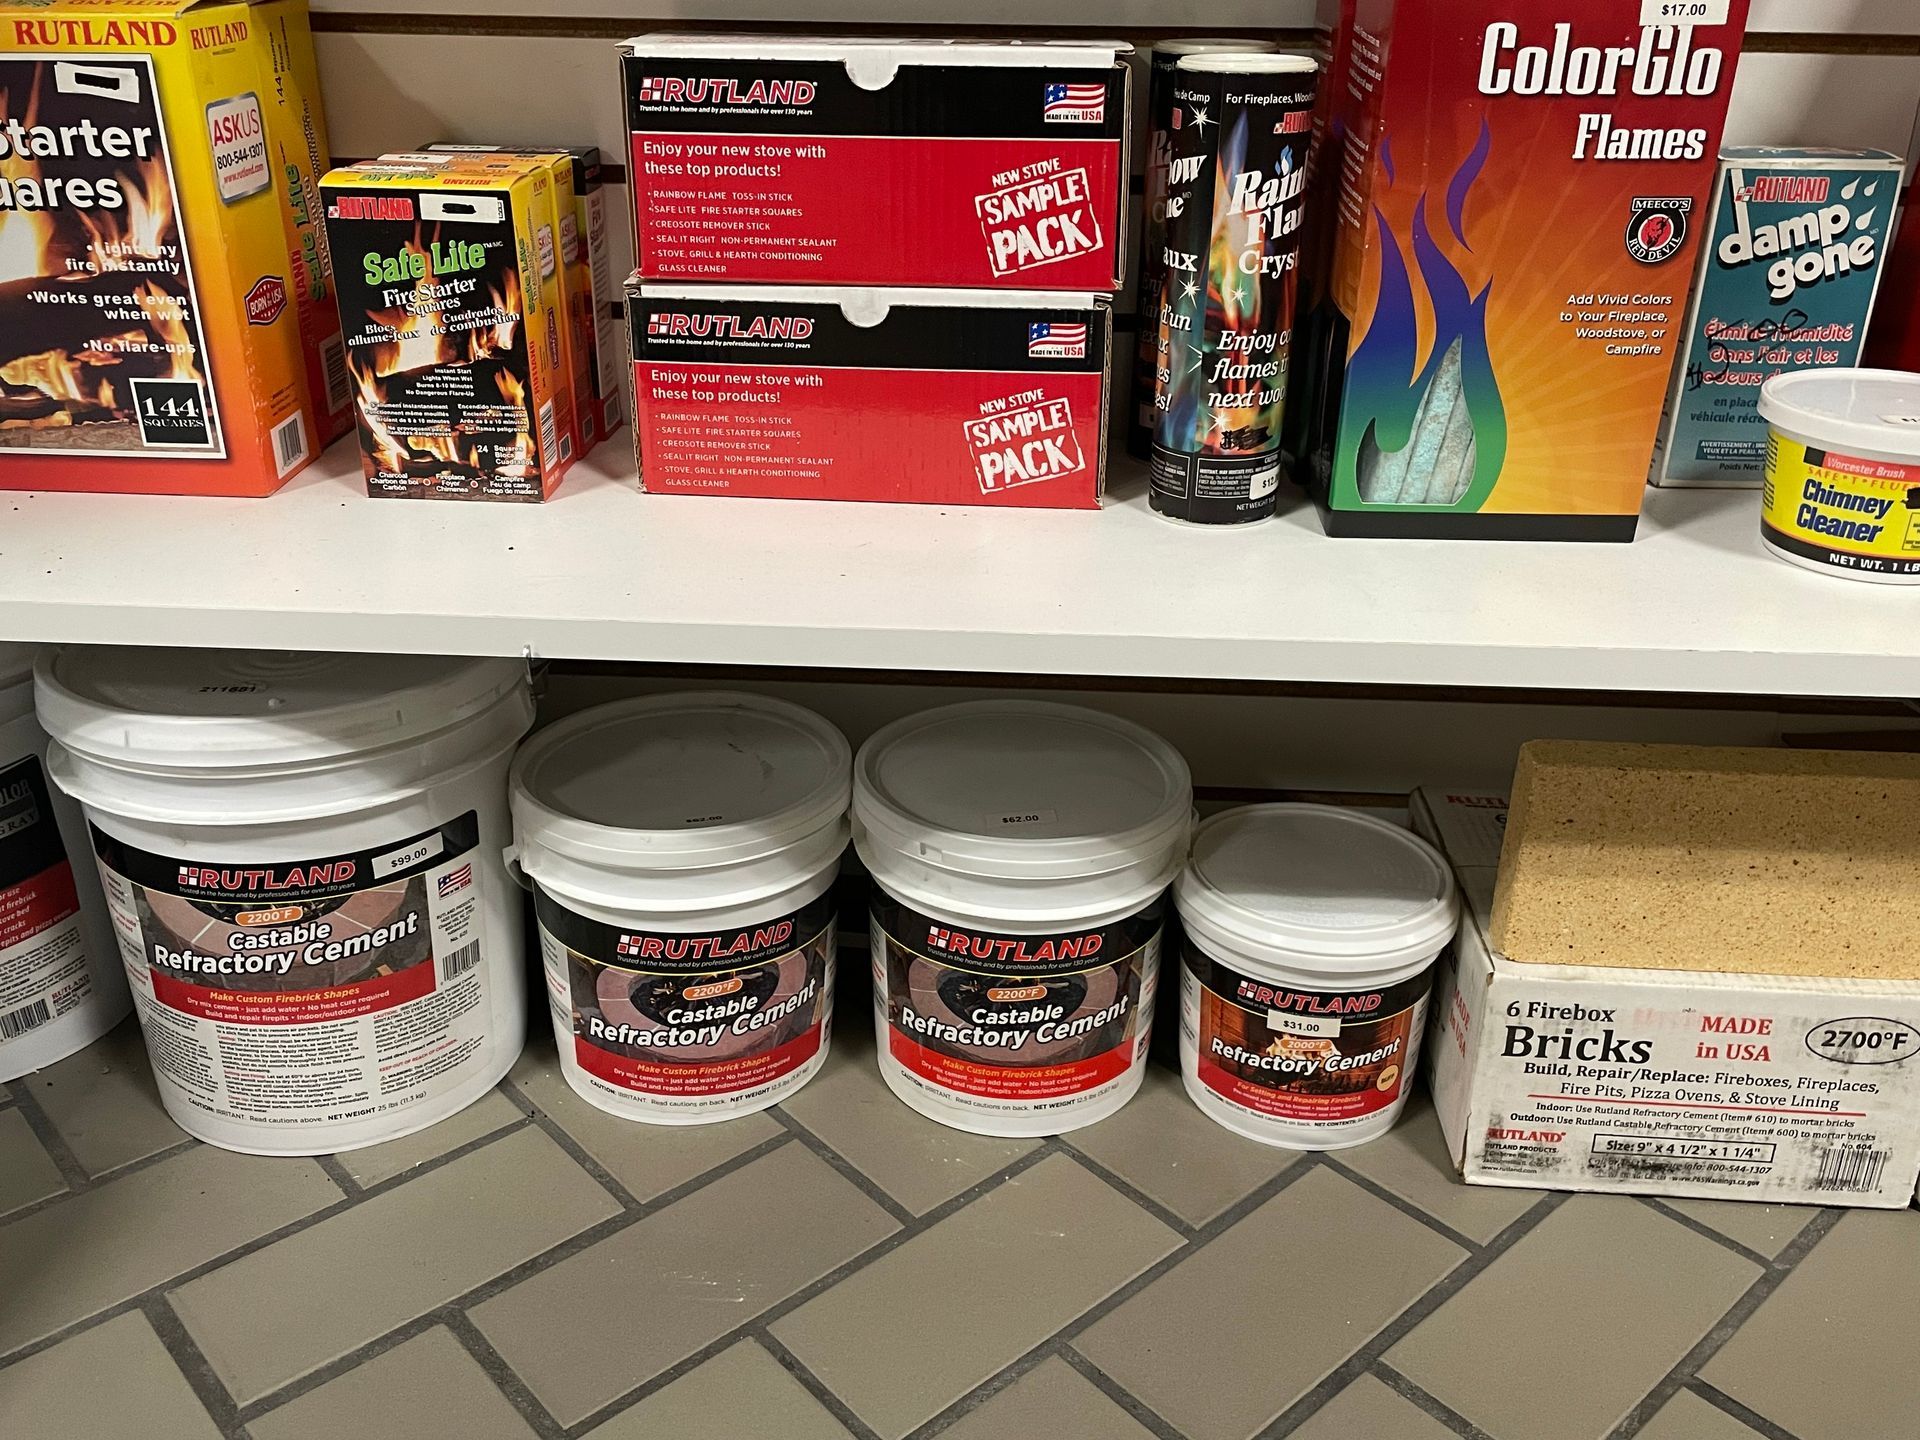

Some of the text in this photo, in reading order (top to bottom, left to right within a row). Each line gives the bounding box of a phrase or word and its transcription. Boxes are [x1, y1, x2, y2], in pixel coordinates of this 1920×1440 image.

[1661, 4, 1707, 17] $17.00
[13, 20, 177, 46] RUTLAND
[190, 21, 248, 50] RUTLAND
[1478, 22, 1723, 96] ColorGlo
[664, 77, 816, 105] RUTLAND
[1226, 94, 1293, 105] For Fireplaces,
[1046, 113, 1062, 121] MADE
[1081, 110, 1102, 121] USA
[1572, 113, 1706, 160] Flames
[217, 142, 263, 170] 800-544-1307
[644, 141, 827, 158] Enjoy your new stove with
[223, 163, 265, 184] www.rutland.com
[644, 161, 781, 178] these top products!
[992, 157, 1061, 188] NEW STOVE
[653, 191, 793, 202] RAINBOW FLAME TOSS-IN STICK
[984, 175, 1084, 225] SAMPLE
[1753, 177, 1830, 203] RUTLAND
[336, 197, 414, 220] RUTLAND
[1635, 200, 1689, 209] MEECO'S
[1719, 168, 1850, 265] damp
[656, 235, 837, 247] SEAL IT RIGHT NON-PERMANENT SEALANT
[991, 209, 1093, 270] PACK
[1628, 236, 1681, 261] RED DEVIL
[65, 258, 181, 276] fire instantly
[363, 239, 486, 286] Safe Lite
[1768, 236, 1875, 298] gone
[33, 291, 187, 307] Works great even
[406, 296, 461, 317] Squares
[1567, 294, 1672, 305] Add Vivid Colors
[104, 308, 190, 321] when wet
[431, 311, 521, 336] de combustion
[442, 306, 504, 324] Cuadrados
[1560, 311, 1668, 323] to Your Fireplace,
[365, 323, 396, 335] Blocs
[669, 313, 814, 340] RUTLAND
[1576, 327, 1666, 340] Woodstove, or
[90, 340, 196, 355] No flare-ups
[1216, 330, 1277, 355] Enjoy
[1605, 344, 1662, 357] Campfire
[1710, 346, 1838, 364] dans l'air et les
[651, 369, 823, 387] Enjoy your new stove with
[1208, 358, 1278, 384] flames
[652, 387, 781, 403] these top products!
[979, 388, 1045, 415] NEW STOVE
[1208, 390, 1254, 407] next
[142, 397, 200, 417] 144
[143, 418, 204, 428] SQUARES
[972, 404, 1067, 448] SAMPLE
[477, 444, 489, 453] 24
[979, 435, 1076, 488] PACK
[1827, 456, 1906, 479] Worcester Brush
[1803, 478, 1894, 519] Chimney
[1796, 503, 1884, 543] Cleaner
[1829, 553, 1856, 567] NET
[1860, 558, 1885, 571] WT.
[1892, 563, 1899, 572] 1
[1002, 814, 1039, 824] $62.00
[391, 847, 428, 868] $99.00
[200, 861, 356, 890] RUTLAND
[6, 892, 37, 909] firebrick
[247, 909, 293, 924] 2200°F
[4, 921, 27, 935] cracks
[229, 922, 331, 950] Castable
[154, 945, 296, 975] Refractory
[303, 912, 419, 966] Cement
[641, 921, 793, 960] RUTLAND
[949, 933, 1103, 962] RUTLAND
[210, 986, 360, 1004] Make Custom Firebrick Shapes
[692, 981, 736, 998] 2200°F
[996, 989, 1039, 1000] 2200°F
[1255, 986, 1382, 1014] RUTLAND
[590, 977, 816, 1048] Refractory Cement
[667, 997, 759, 1025] Castable
[971, 1004, 1064, 1026] Castable
[1506, 1001, 1617, 1023] 6 Firebox
[902, 995, 1129, 1050] Refractory Cement
[1283, 1020, 1320, 1033] $31.00
[1700, 1016, 1773, 1036] MADE
[1287, 1041, 1326, 1050] 2000°F
[1500, 1025, 1653, 1064] Bricks
[1821, 1030, 1909, 1050] 2700°F
[1211, 1036, 1401, 1076] Refractory Cement
[1696, 1042, 1771, 1062] in USA
[1524, 1062, 1880, 1094] Build, Repair/Replace: Fireboxes, Fireplaces,
[1561, 1082, 1840, 1111] Fire Pits, Pizza Ovens, & Stove Lining
[1488, 1128, 1566, 1143] RUTLAND
